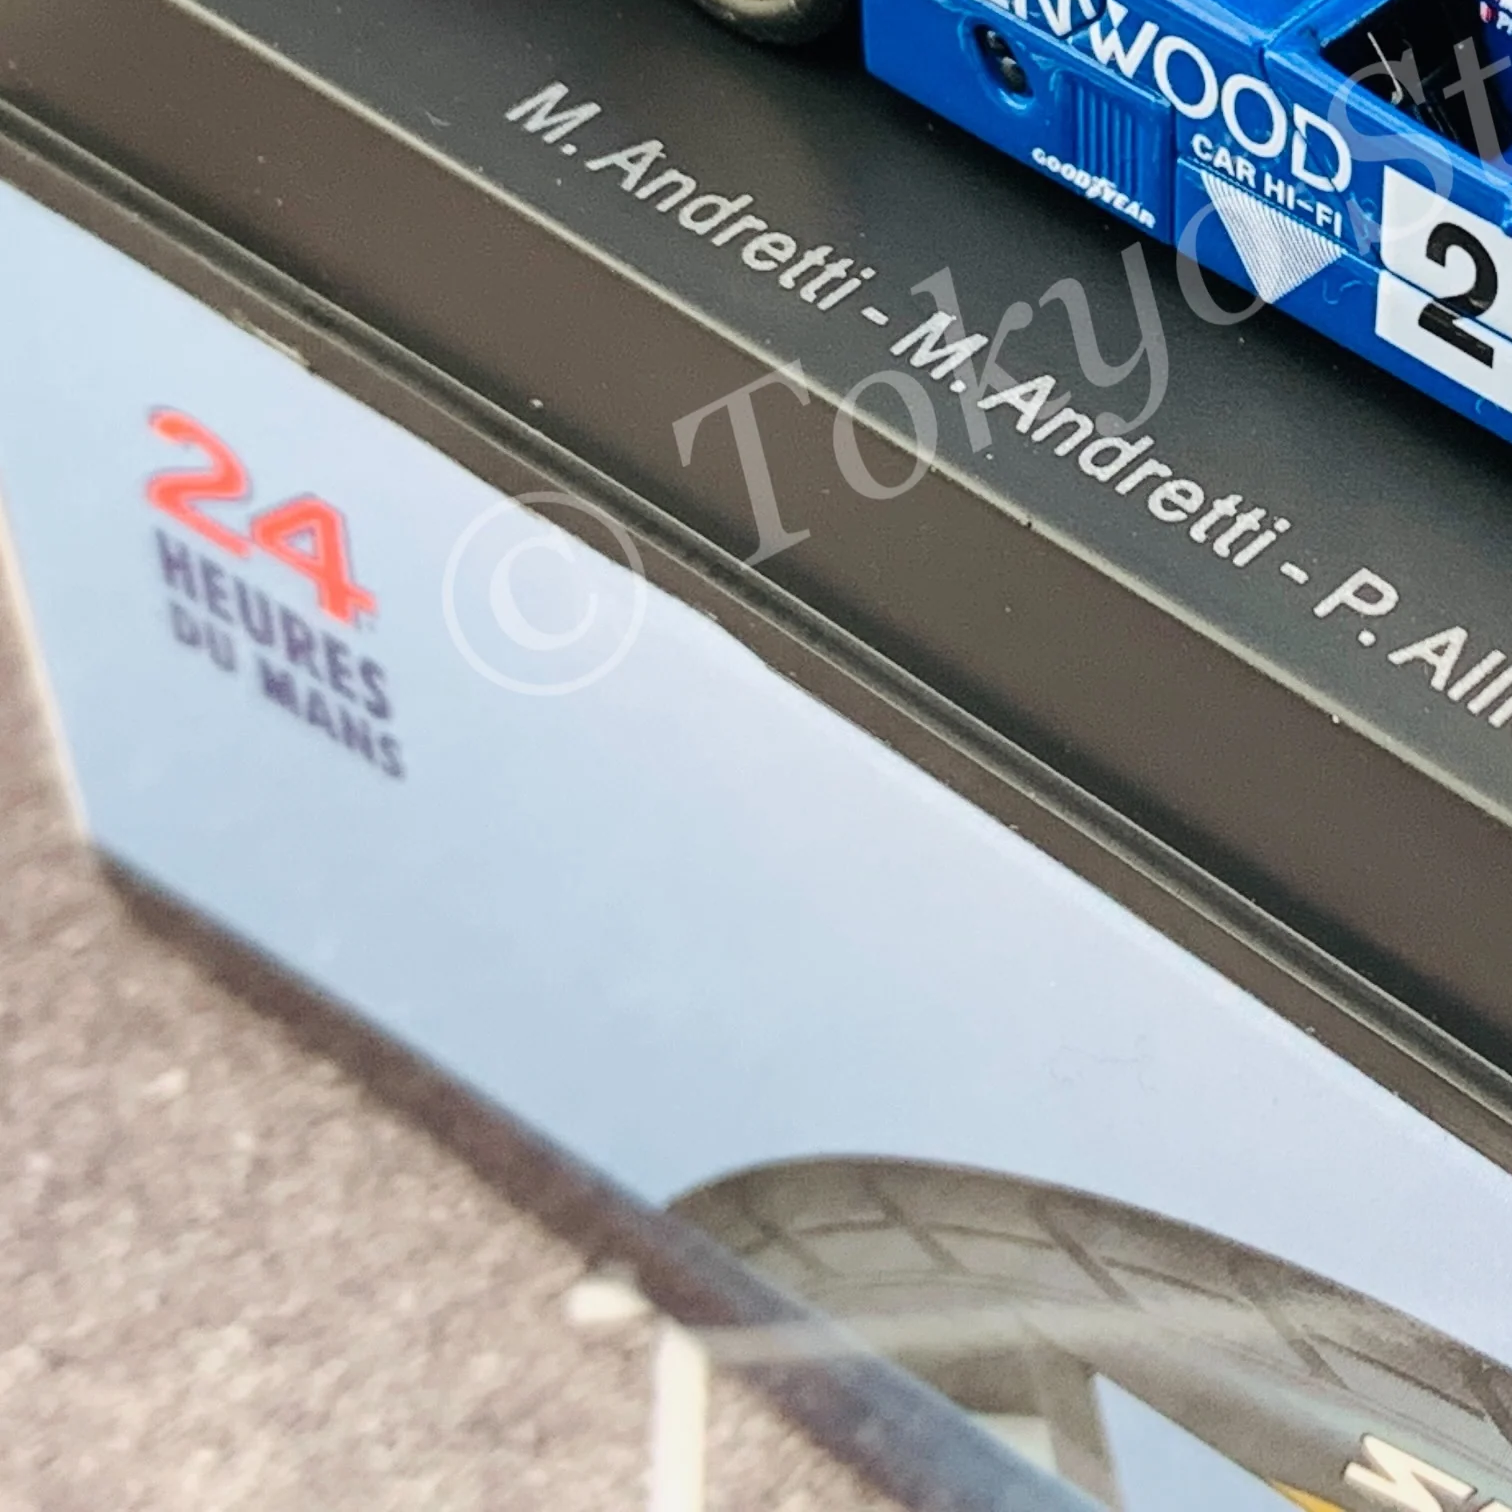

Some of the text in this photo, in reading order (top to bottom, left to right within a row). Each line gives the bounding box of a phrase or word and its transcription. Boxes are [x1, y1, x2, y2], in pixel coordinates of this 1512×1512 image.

[1030, 146, 1157, 231] GOODYEAR
[1192, 133, 1343, 237] CAR HI-FI
[504, 80, 603, 157] M.
[585, 137, 877, 312] Andretti
[889, 309, 989, 395] M.
[976, 373, 1292, 569] Andretti
[1312, 568, 1401, 648] P.
[145, 406, 378, 625] 24
[155, 528, 391, 721] HEURES
[167, 599, 406, 782] DU MANS
